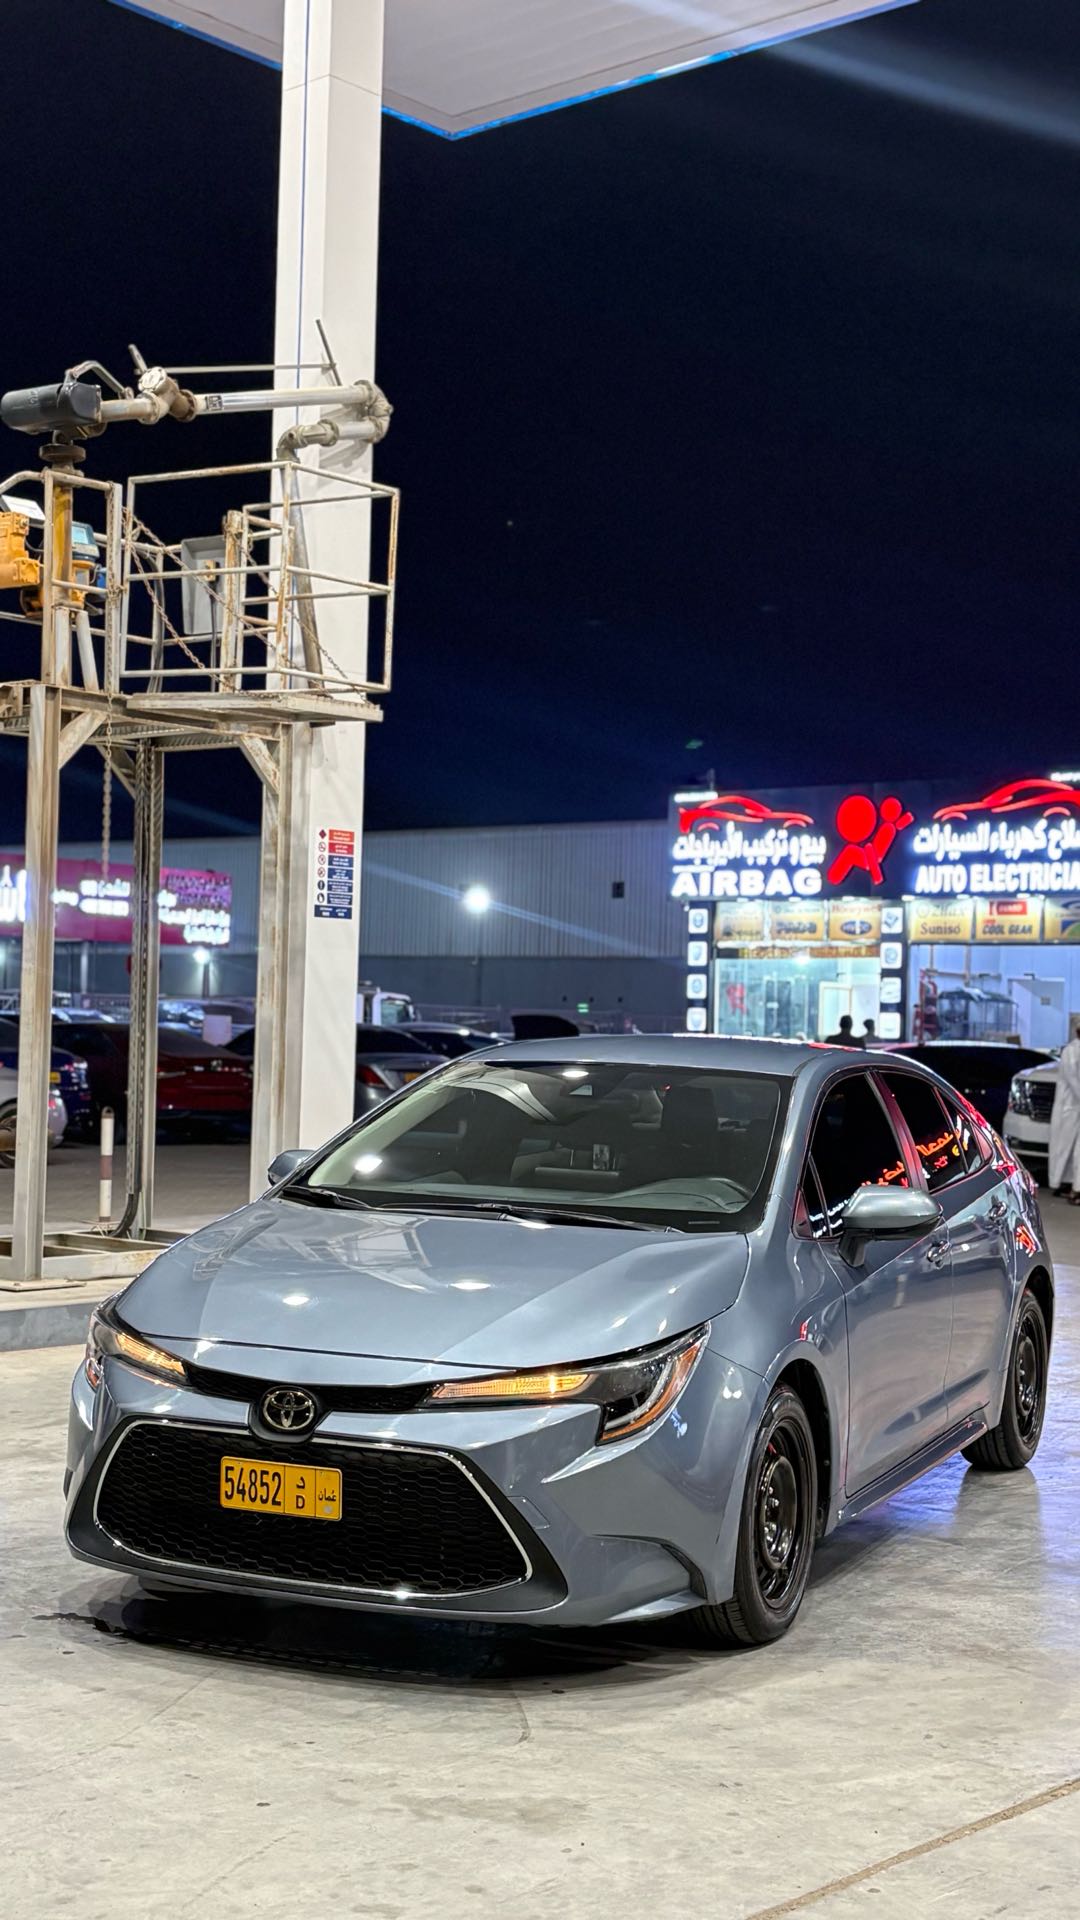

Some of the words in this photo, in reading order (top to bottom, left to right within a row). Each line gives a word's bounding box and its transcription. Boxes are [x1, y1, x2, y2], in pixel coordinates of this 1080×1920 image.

[800, 834, 827, 866] بيع
[913, 821, 990, 862] السيارات
[990, 818, 1047, 860] كهرباء
[671, 868, 822, 897] AIRBAG
[915, 864, 968, 893] AUTO
[982, 924, 1004, 934] COOL
[224, 1465, 282, 1507] 54852
[295, 1494, 306, 1509] D
